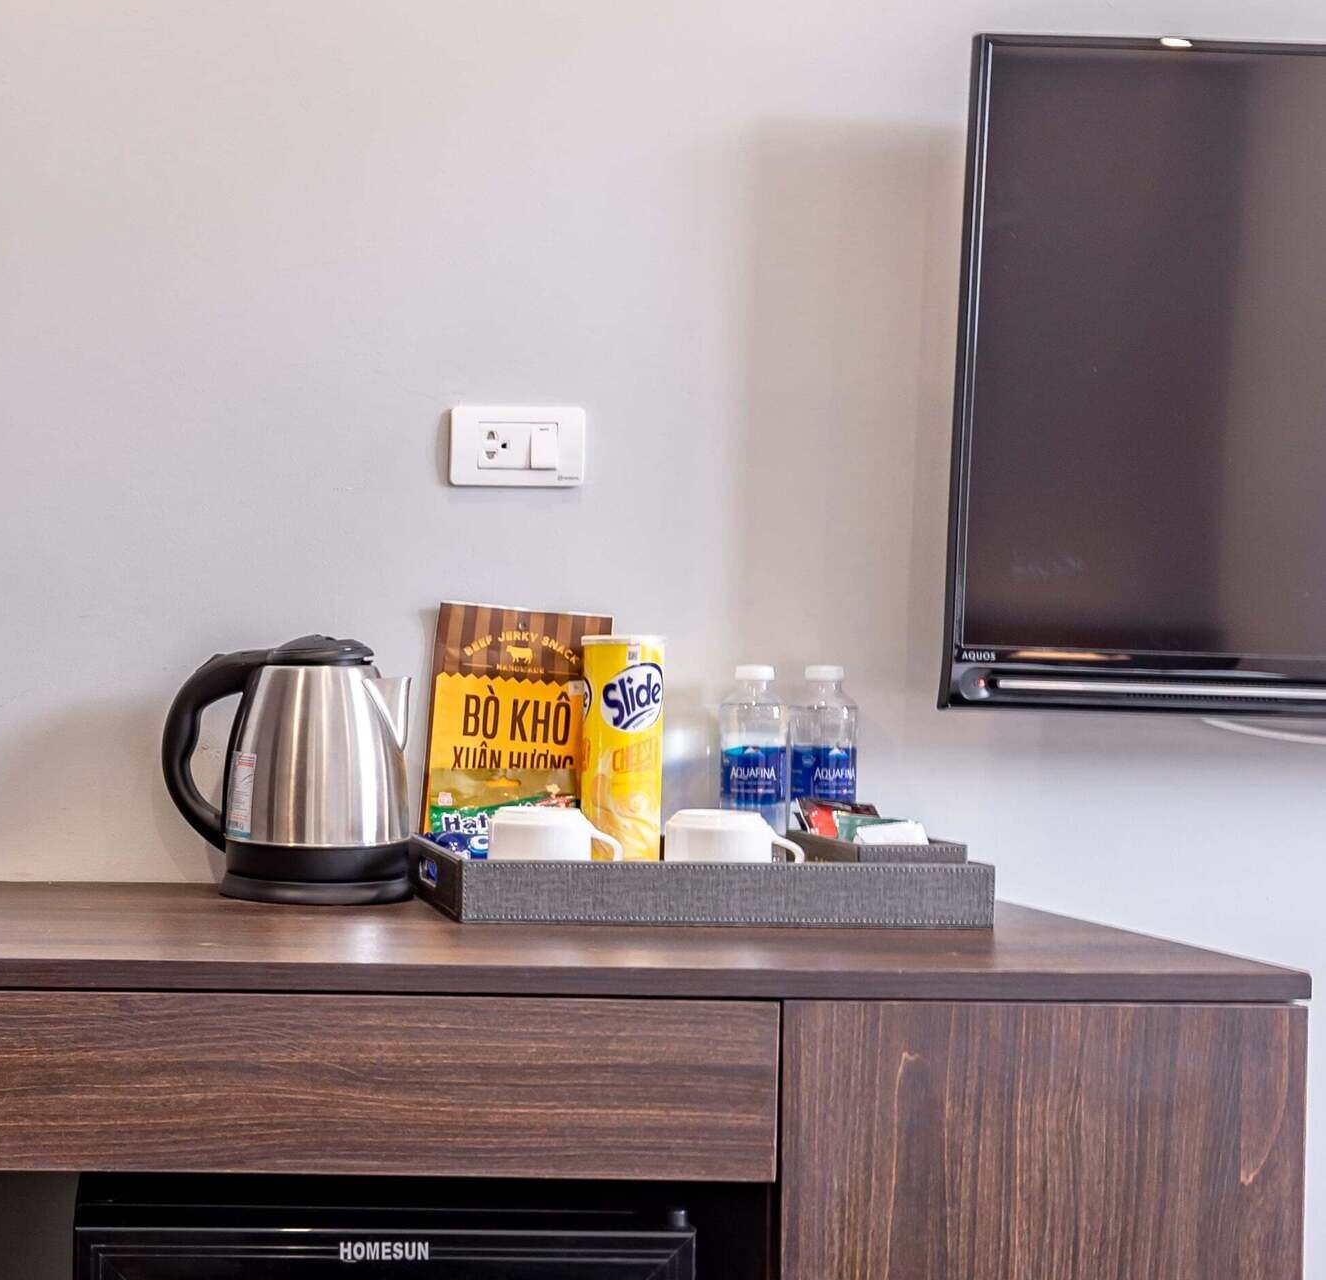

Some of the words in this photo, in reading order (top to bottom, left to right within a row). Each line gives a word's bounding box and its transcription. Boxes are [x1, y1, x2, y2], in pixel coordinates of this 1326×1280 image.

[464, 634, 492, 657] BEEF
[497, 631, 539, 643] JERKY
[541, 635, 579, 665] SNACK
[961, 650, 996, 661] AQUOS
[602, 672, 662, 727] Slide
[462, 684, 500, 740] BÒ
[510, 691, 571, 746] KHÔ
[730, 766, 777, 781] AQUAFINA
[814, 767, 856, 781] AQUAFINA
[339, 1241, 429, 1261] HOMESUN
